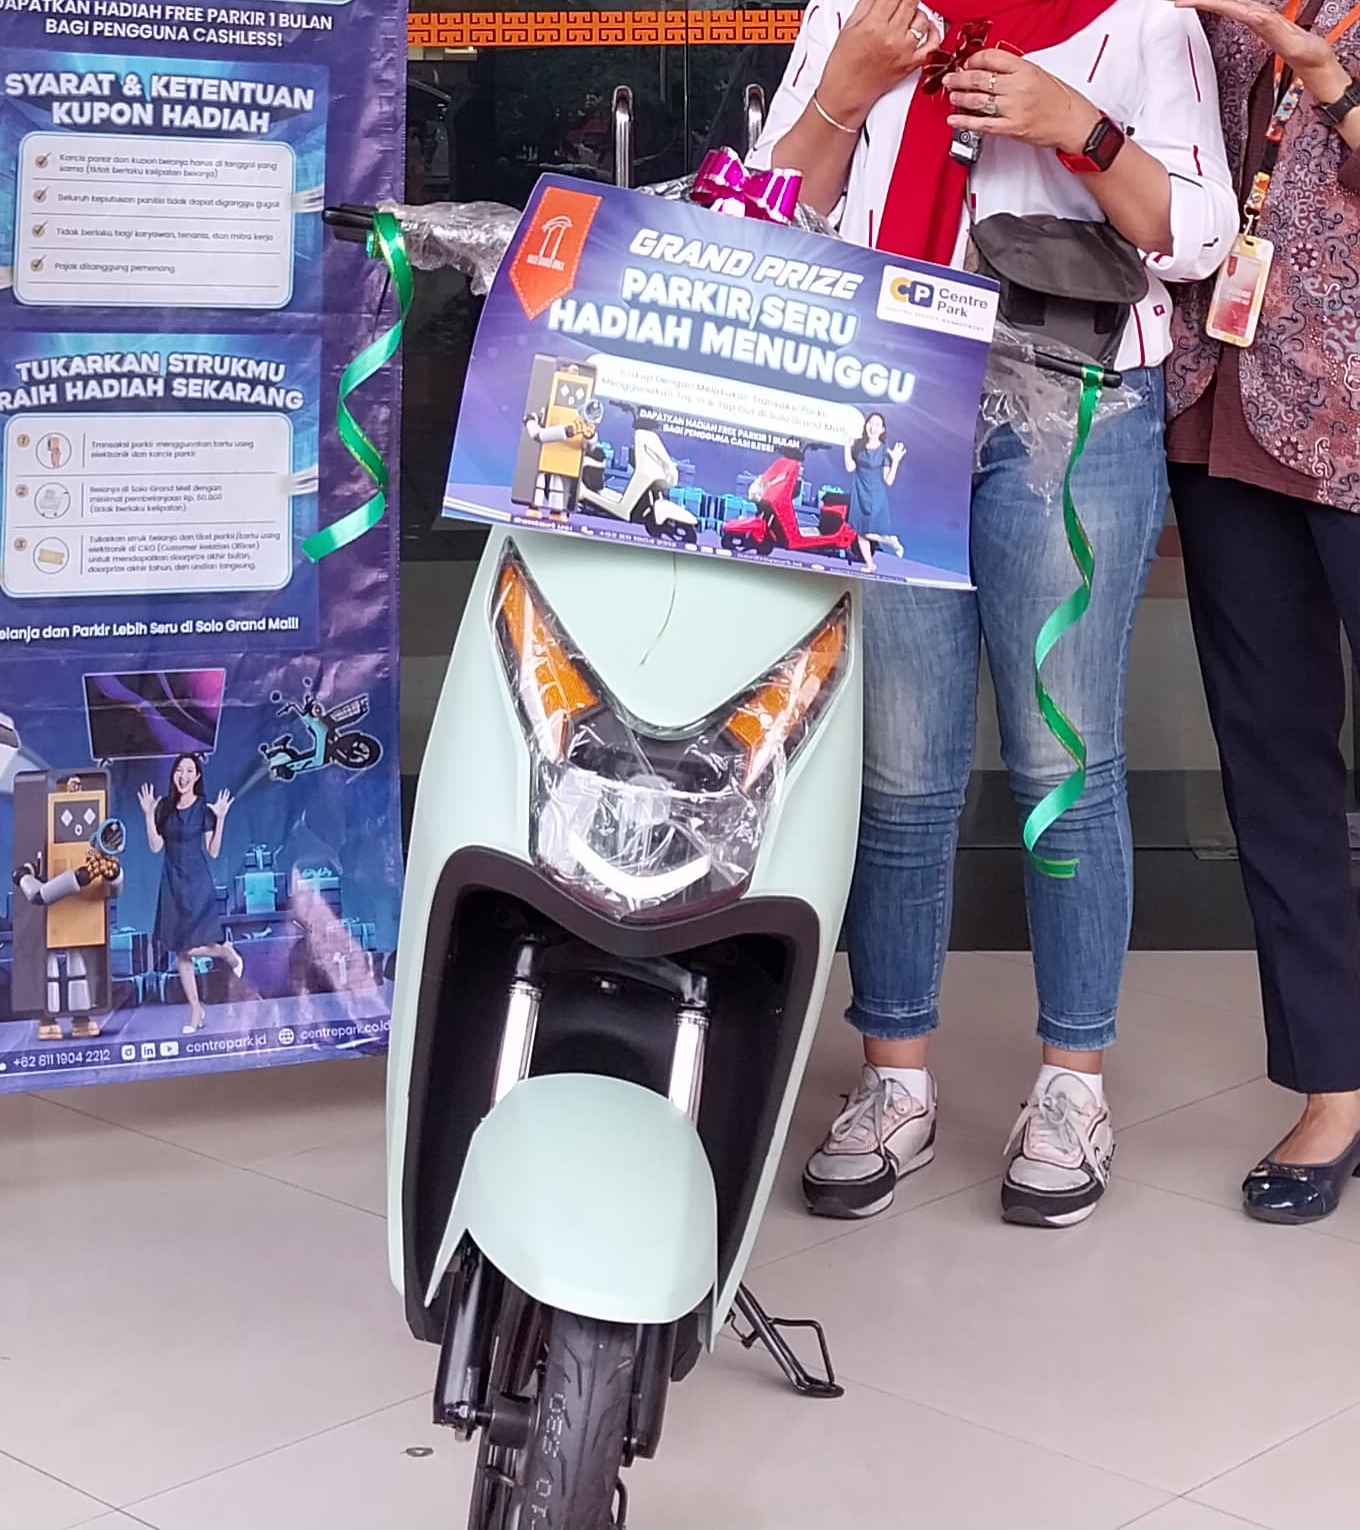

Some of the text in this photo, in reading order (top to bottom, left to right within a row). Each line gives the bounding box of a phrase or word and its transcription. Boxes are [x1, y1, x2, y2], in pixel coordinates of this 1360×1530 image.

[94, 0, 162, 20] HADIAH
[165, 5, 203, 22] FREE
[207, 8, 265, 26] PARKIR
[269, 12, 275, 27] 1
[279, 13, 333, 30] BULAN
[45, 18, 283, 47] BAGI PENGGUNA CASHLESS!
[5, 72, 314, 111] SYARAT & KETENTUAN
[51, 101, 270, 133] KUPON HADIAH
[629, 227, 865, 301] GRAND PRIZE
[622, 267, 754, 322] PARKIR
[759, 295, 858, 346] SERU
[937, 301, 968, 318] Park
[939, 288, 988, 309] Centre
[547, 299, 916, 402] HADIAH MENUNGGU
[15, 352, 286, 383] TUKARKAN STRUKMU
[65, 377, 164, 402] HADIAH
[171, 377, 304, 409] SEKARANG
[43, 626, 69, 638] dan
[72, 624, 110, 637] Parkir
[113, 622, 147, 636] Lebih
[150, 621, 178, 634] Seru
[180, 620, 193, 633] di
[196, 620, 223, 633] Solo
[226, 618, 266, 631] Grand
[85, 1049, 110, 1062] 2212
